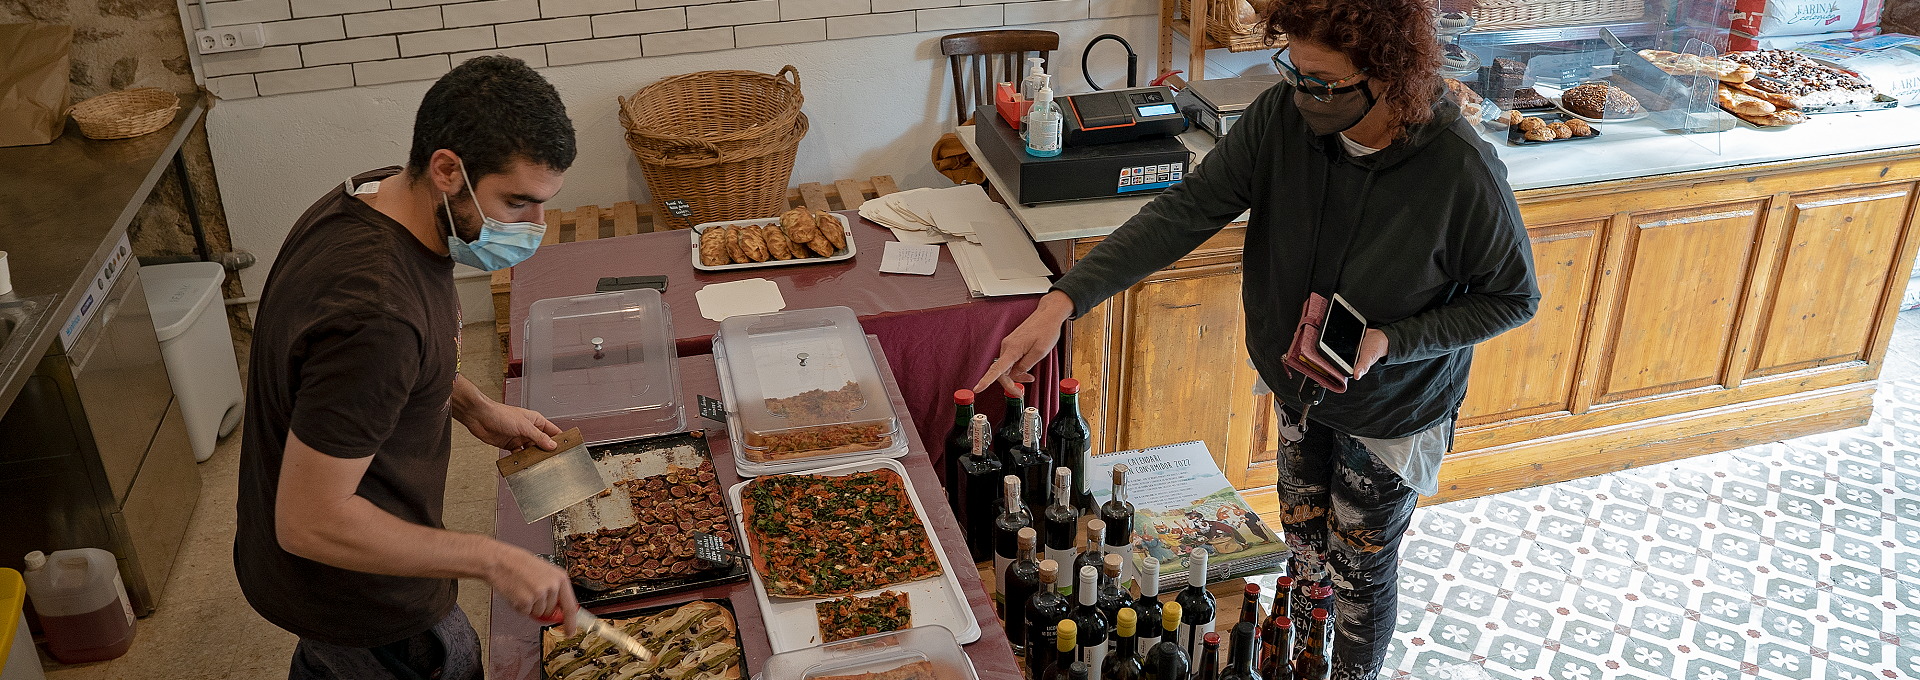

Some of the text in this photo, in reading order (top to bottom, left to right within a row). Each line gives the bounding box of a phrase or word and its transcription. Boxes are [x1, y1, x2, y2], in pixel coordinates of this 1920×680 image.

[1797, 3, 1833, 15] FARINA
[1127, 454, 1161, 466] CALENDARI
[1135, 461, 1174, 474] CONSUMIDOR
[1174, 458, 1191, 468] 2022
